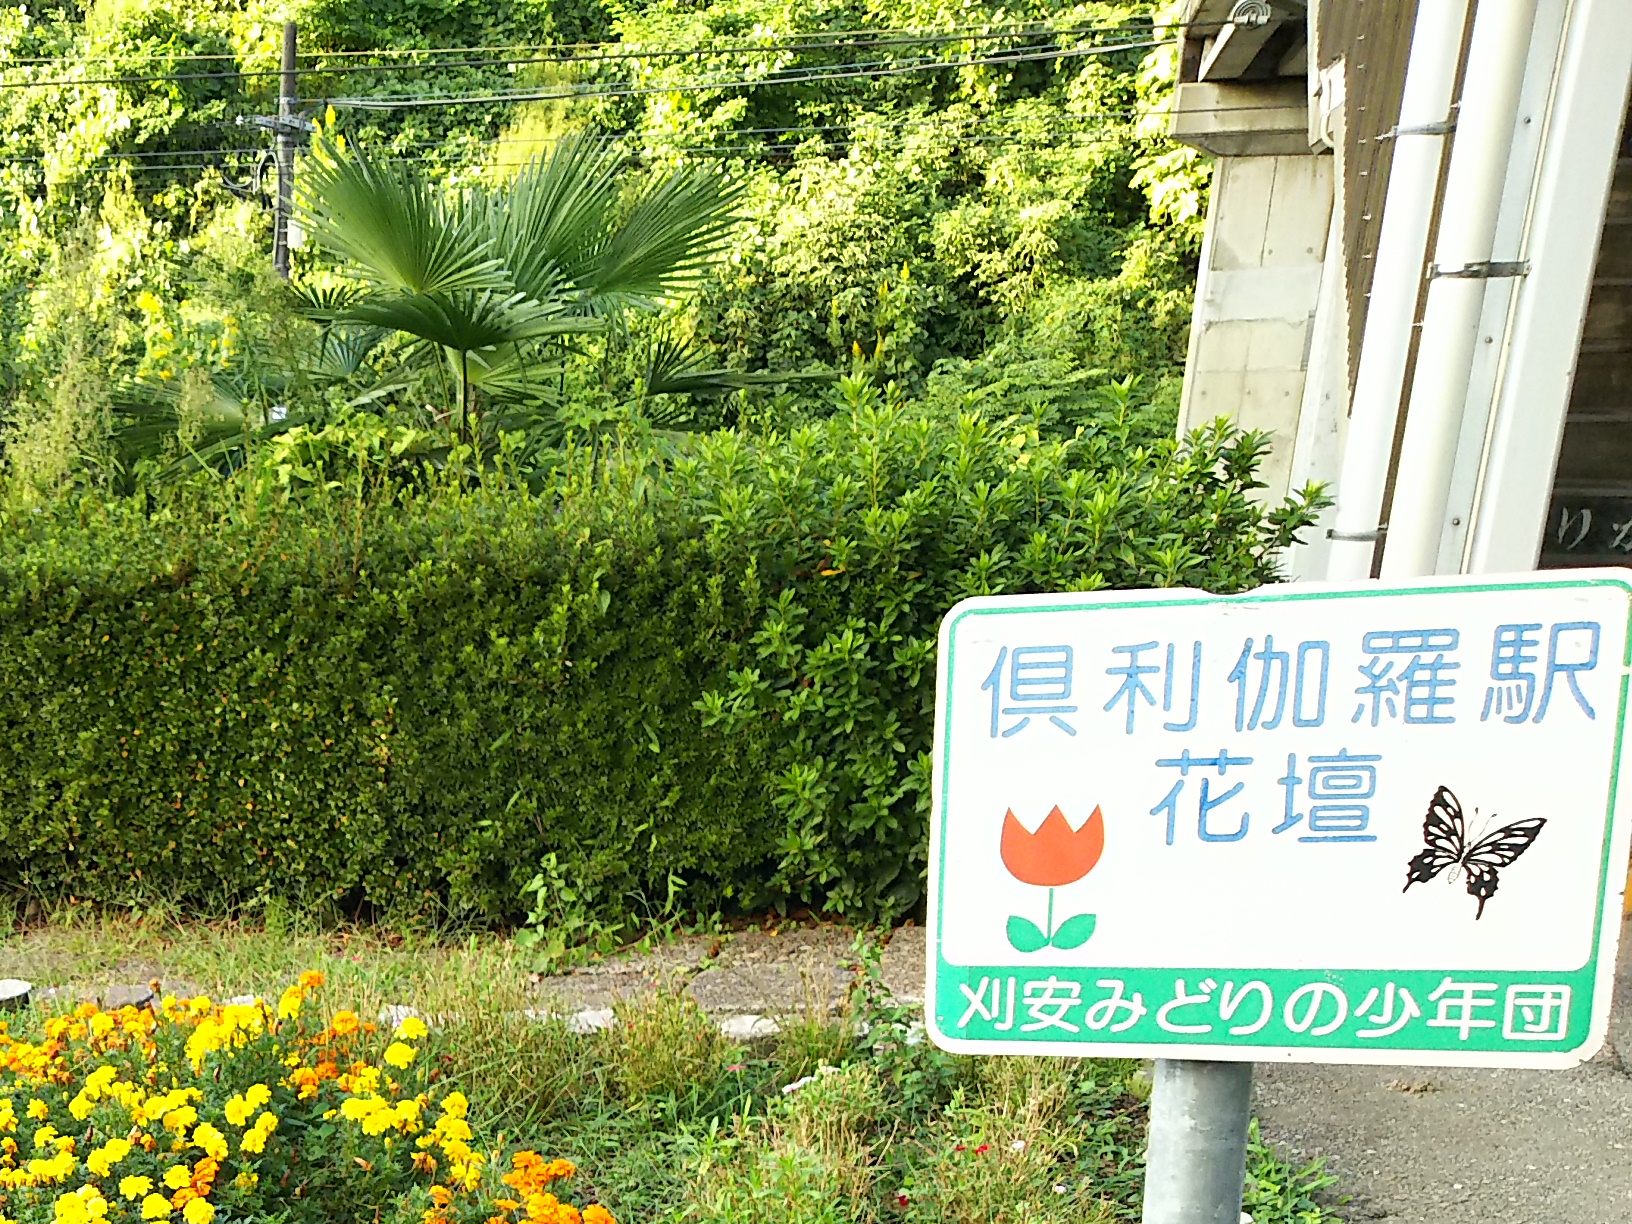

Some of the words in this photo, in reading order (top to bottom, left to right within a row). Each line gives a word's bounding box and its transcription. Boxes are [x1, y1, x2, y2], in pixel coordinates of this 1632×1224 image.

[980, 620, 1602, 738] 倶利伽羅駅
[1149, 747, 1383, 846] 花壇
[957, 975, 1573, 1042] 刈安みどりの少年団
